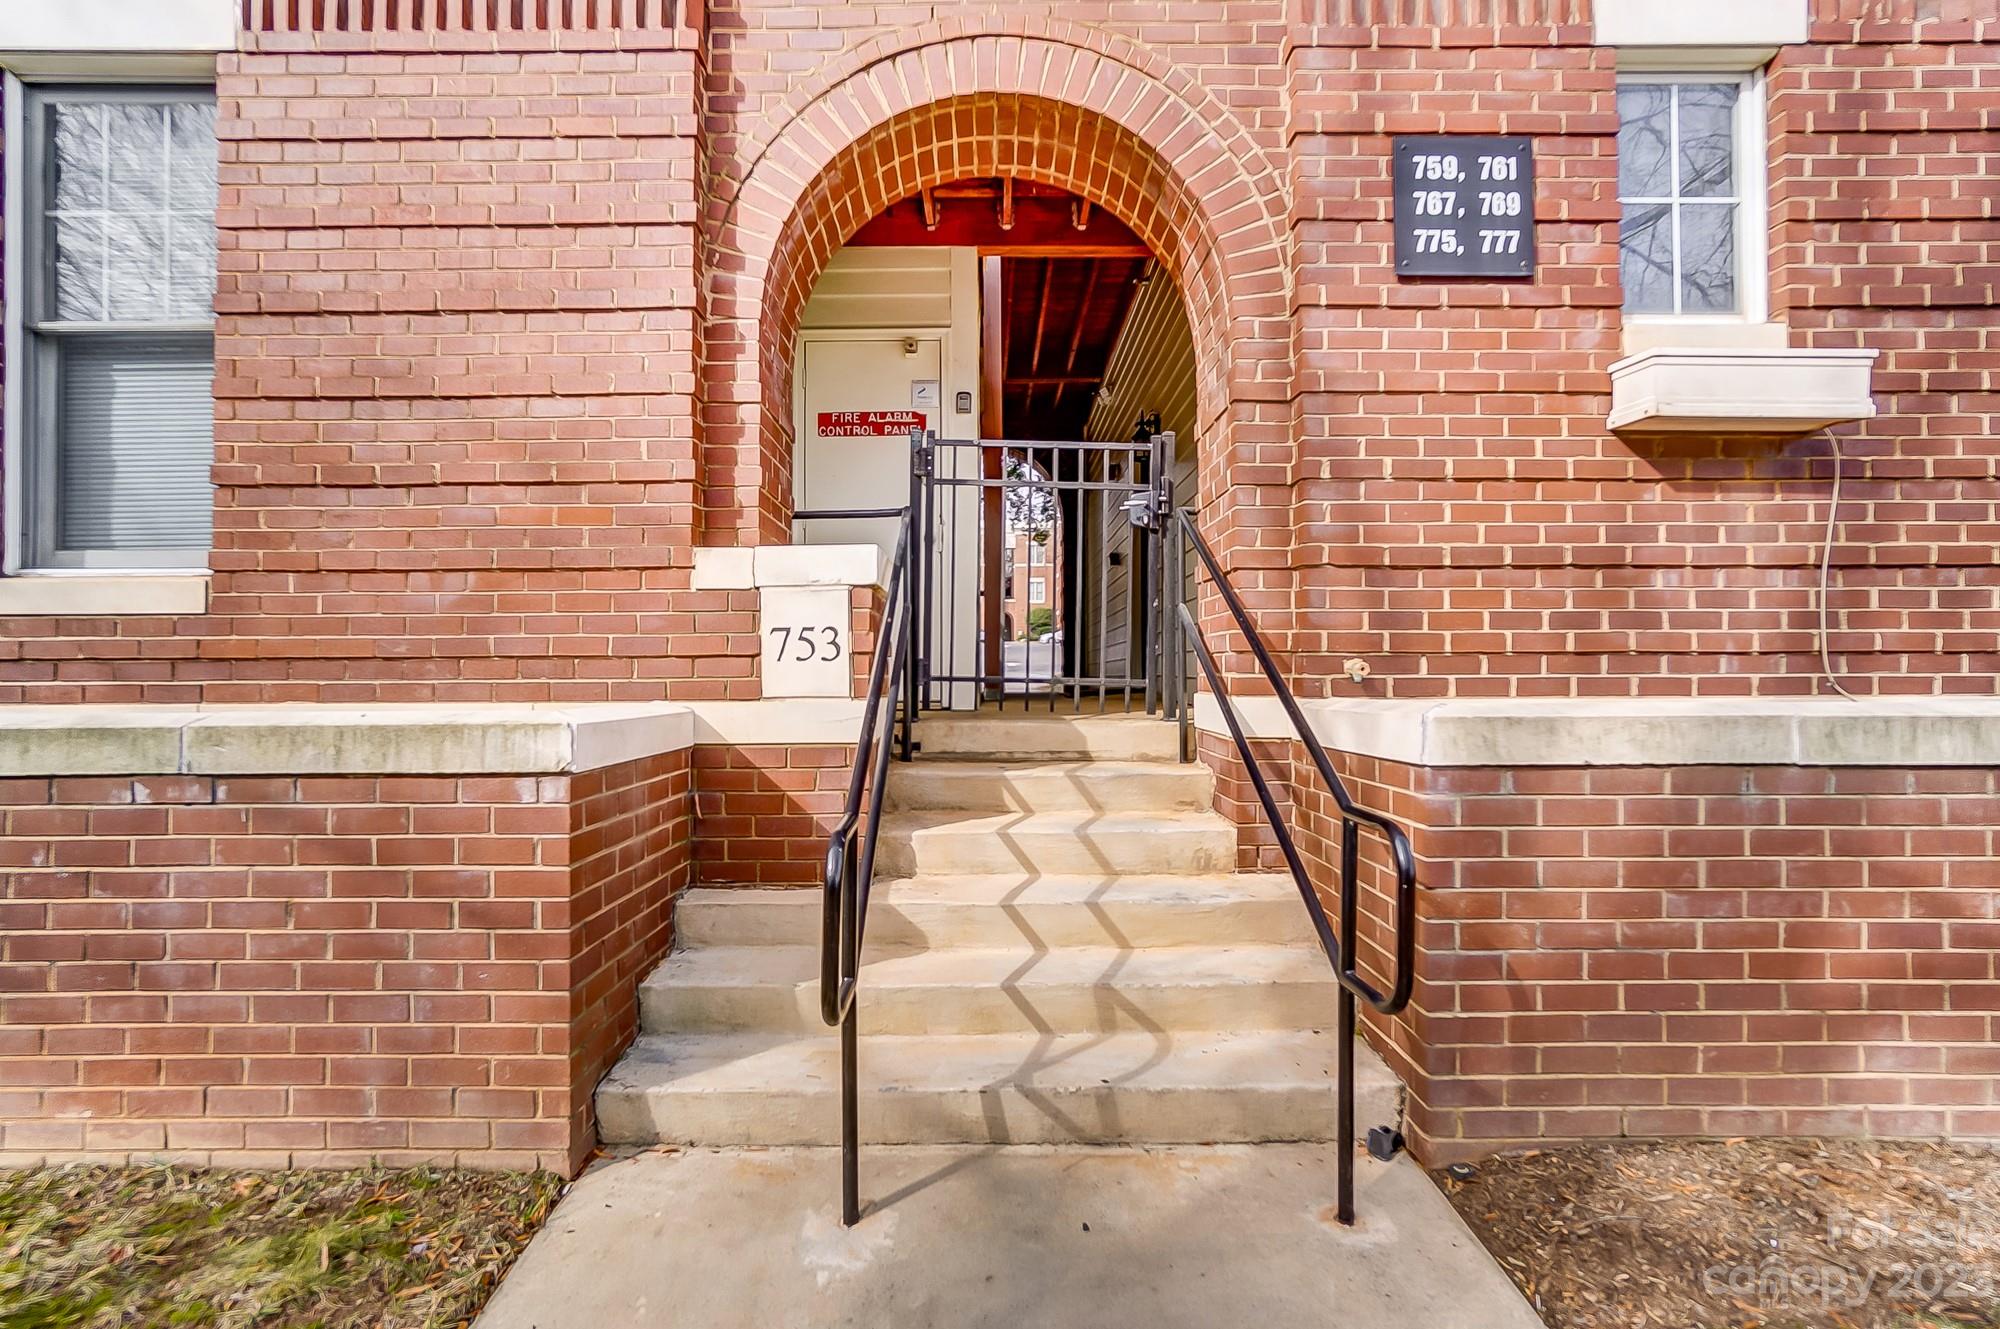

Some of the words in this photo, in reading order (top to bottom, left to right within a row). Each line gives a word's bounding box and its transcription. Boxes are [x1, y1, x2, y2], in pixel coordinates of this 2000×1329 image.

[1412, 155, 1466, 183] 759,
[1478, 156, 1517, 181] 761
[1412, 191, 1466, 219] 767,
[1478, 192, 1521, 216] 769
[1413, 229, 1465, 257] 775,
[1478, 230, 1521, 254] 777
[818, 425, 878, 436] CONTROL
[832, 412, 861, 423] FIRE
[868, 411, 913, 423] ALARM
[769, 626, 841, 662] 753
